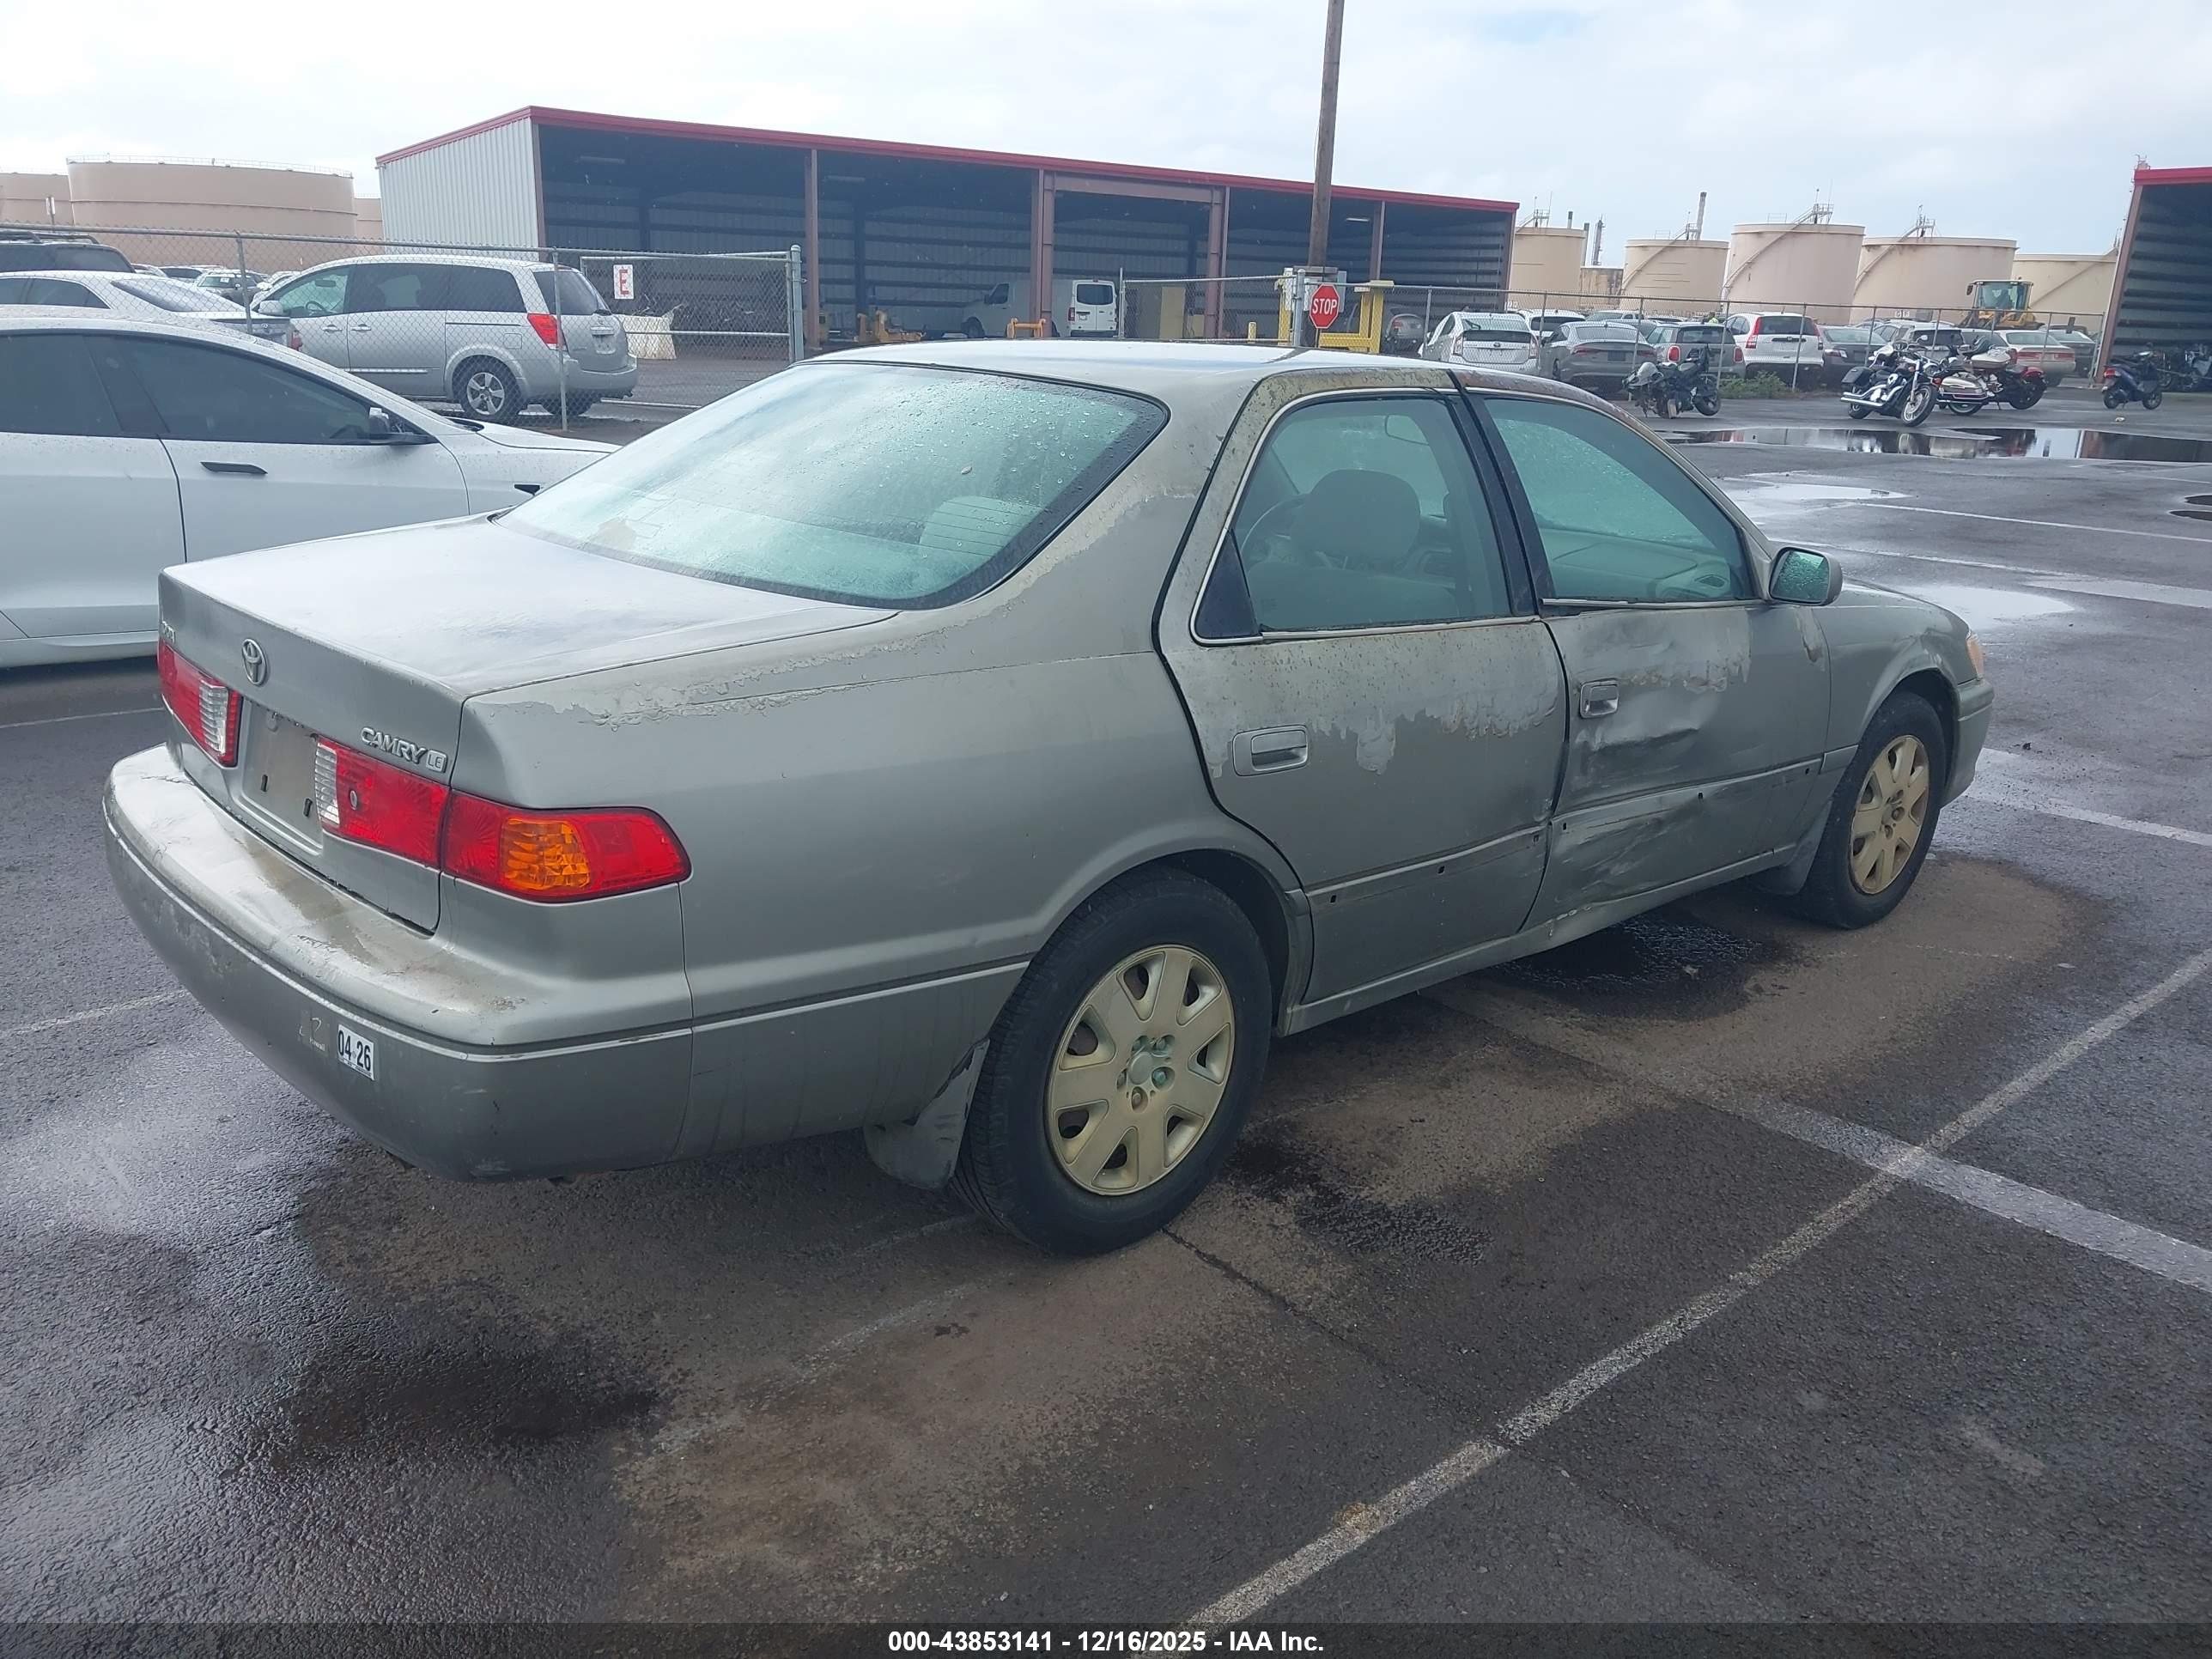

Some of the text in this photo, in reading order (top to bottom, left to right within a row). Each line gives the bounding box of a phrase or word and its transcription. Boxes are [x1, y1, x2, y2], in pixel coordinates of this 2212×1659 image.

[618, 269, 629, 295] E
[1312, 298, 1338, 315] STOP
[361, 726, 444, 769] CAMRY LE
[337, 1030, 352, 1060] 04
[356, 1040, 371, 1072] 26
